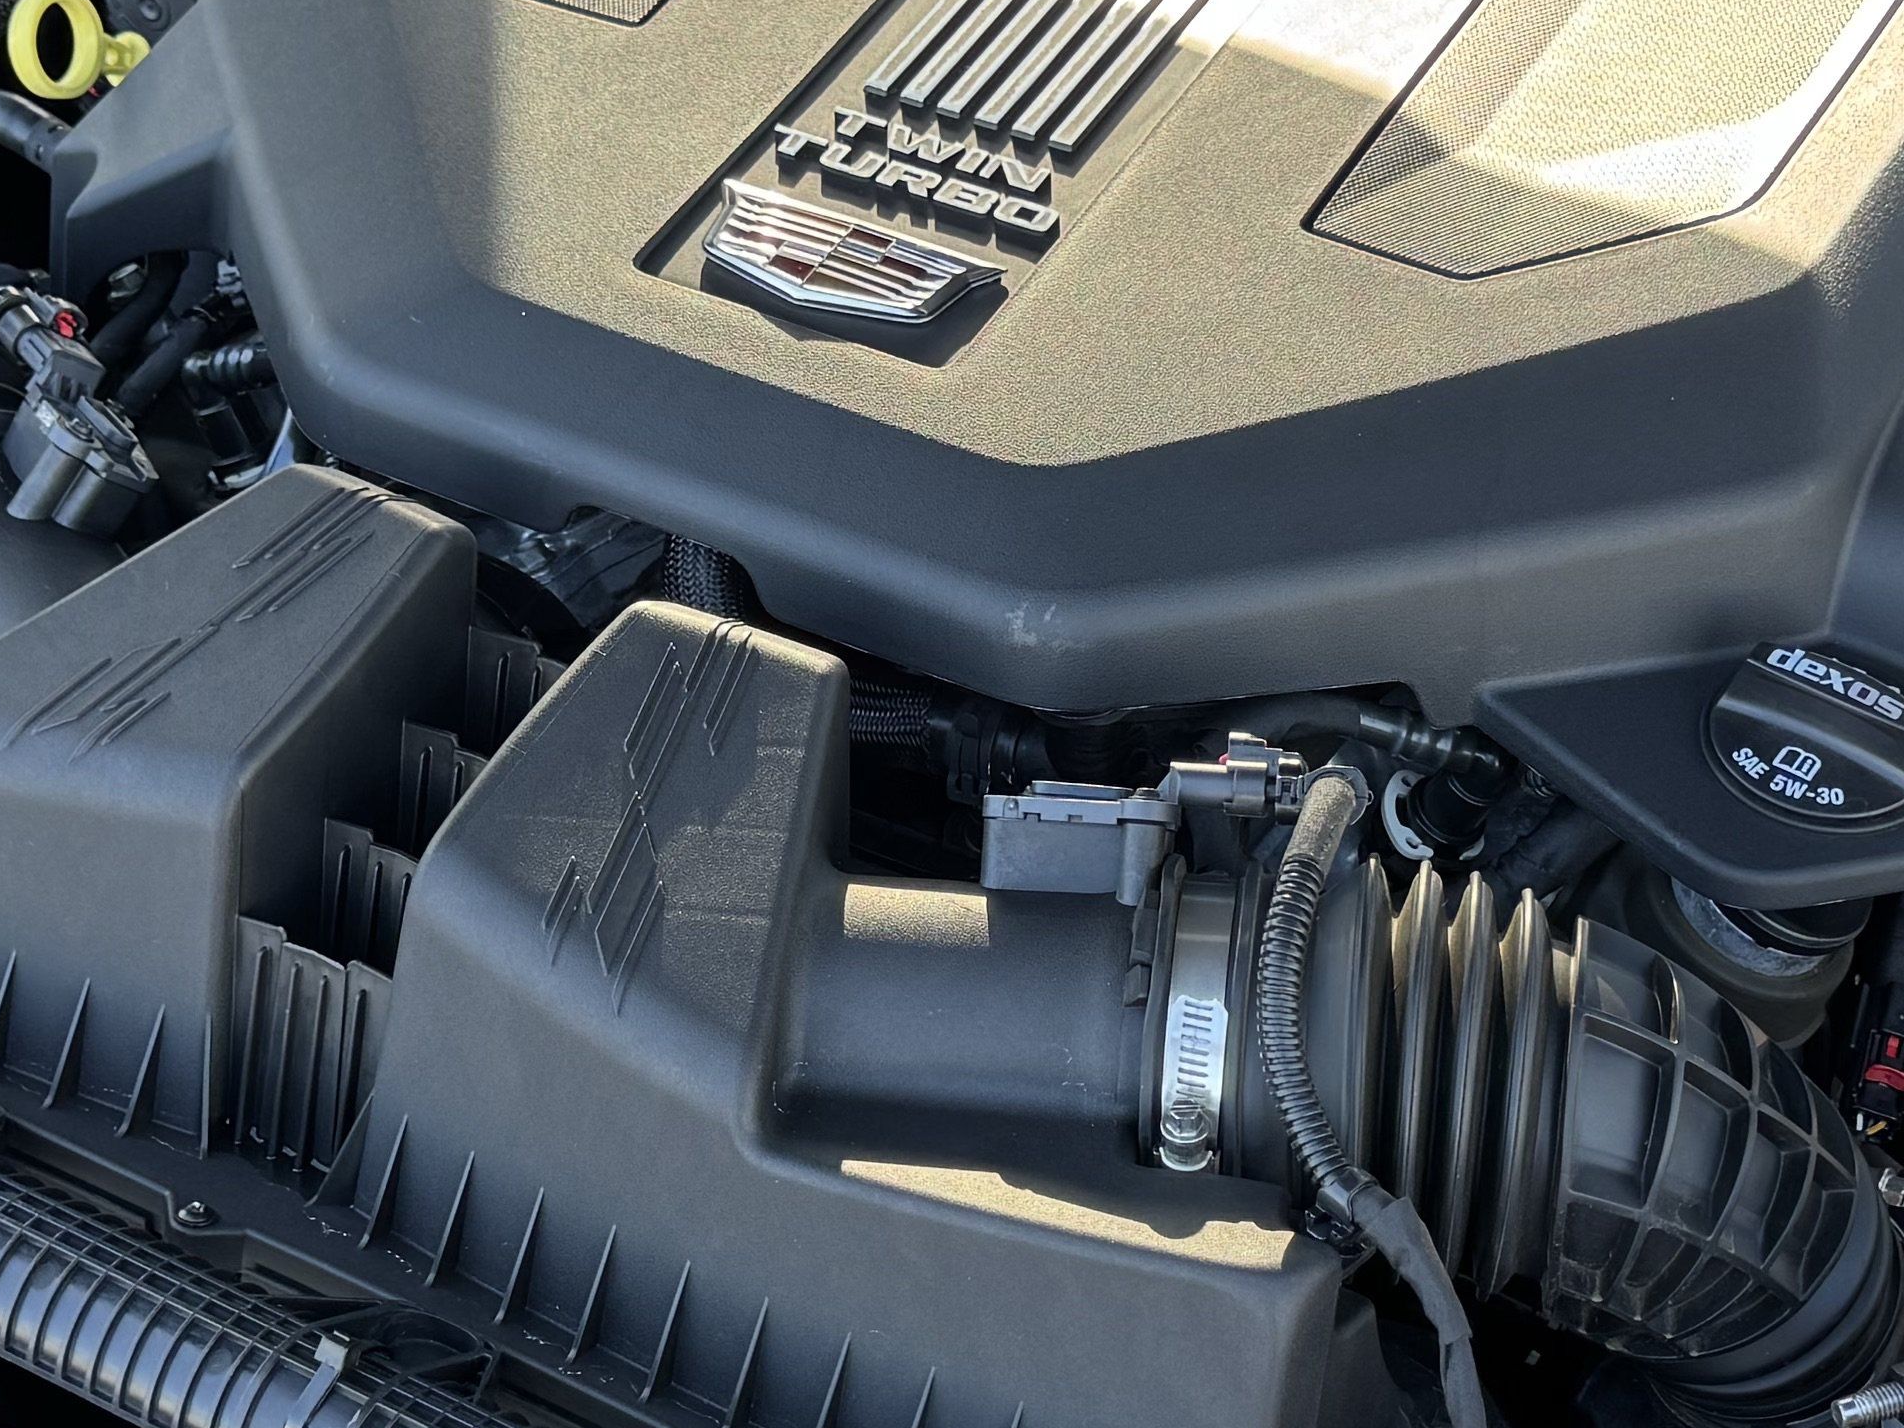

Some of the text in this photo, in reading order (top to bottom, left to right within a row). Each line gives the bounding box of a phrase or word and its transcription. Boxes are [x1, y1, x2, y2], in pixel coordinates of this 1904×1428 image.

[774, 123, 1061, 233] TURBO
[834, 105, 1053, 193] TWIN
[1731, 747, 1845, 806] SAE 5W-30
